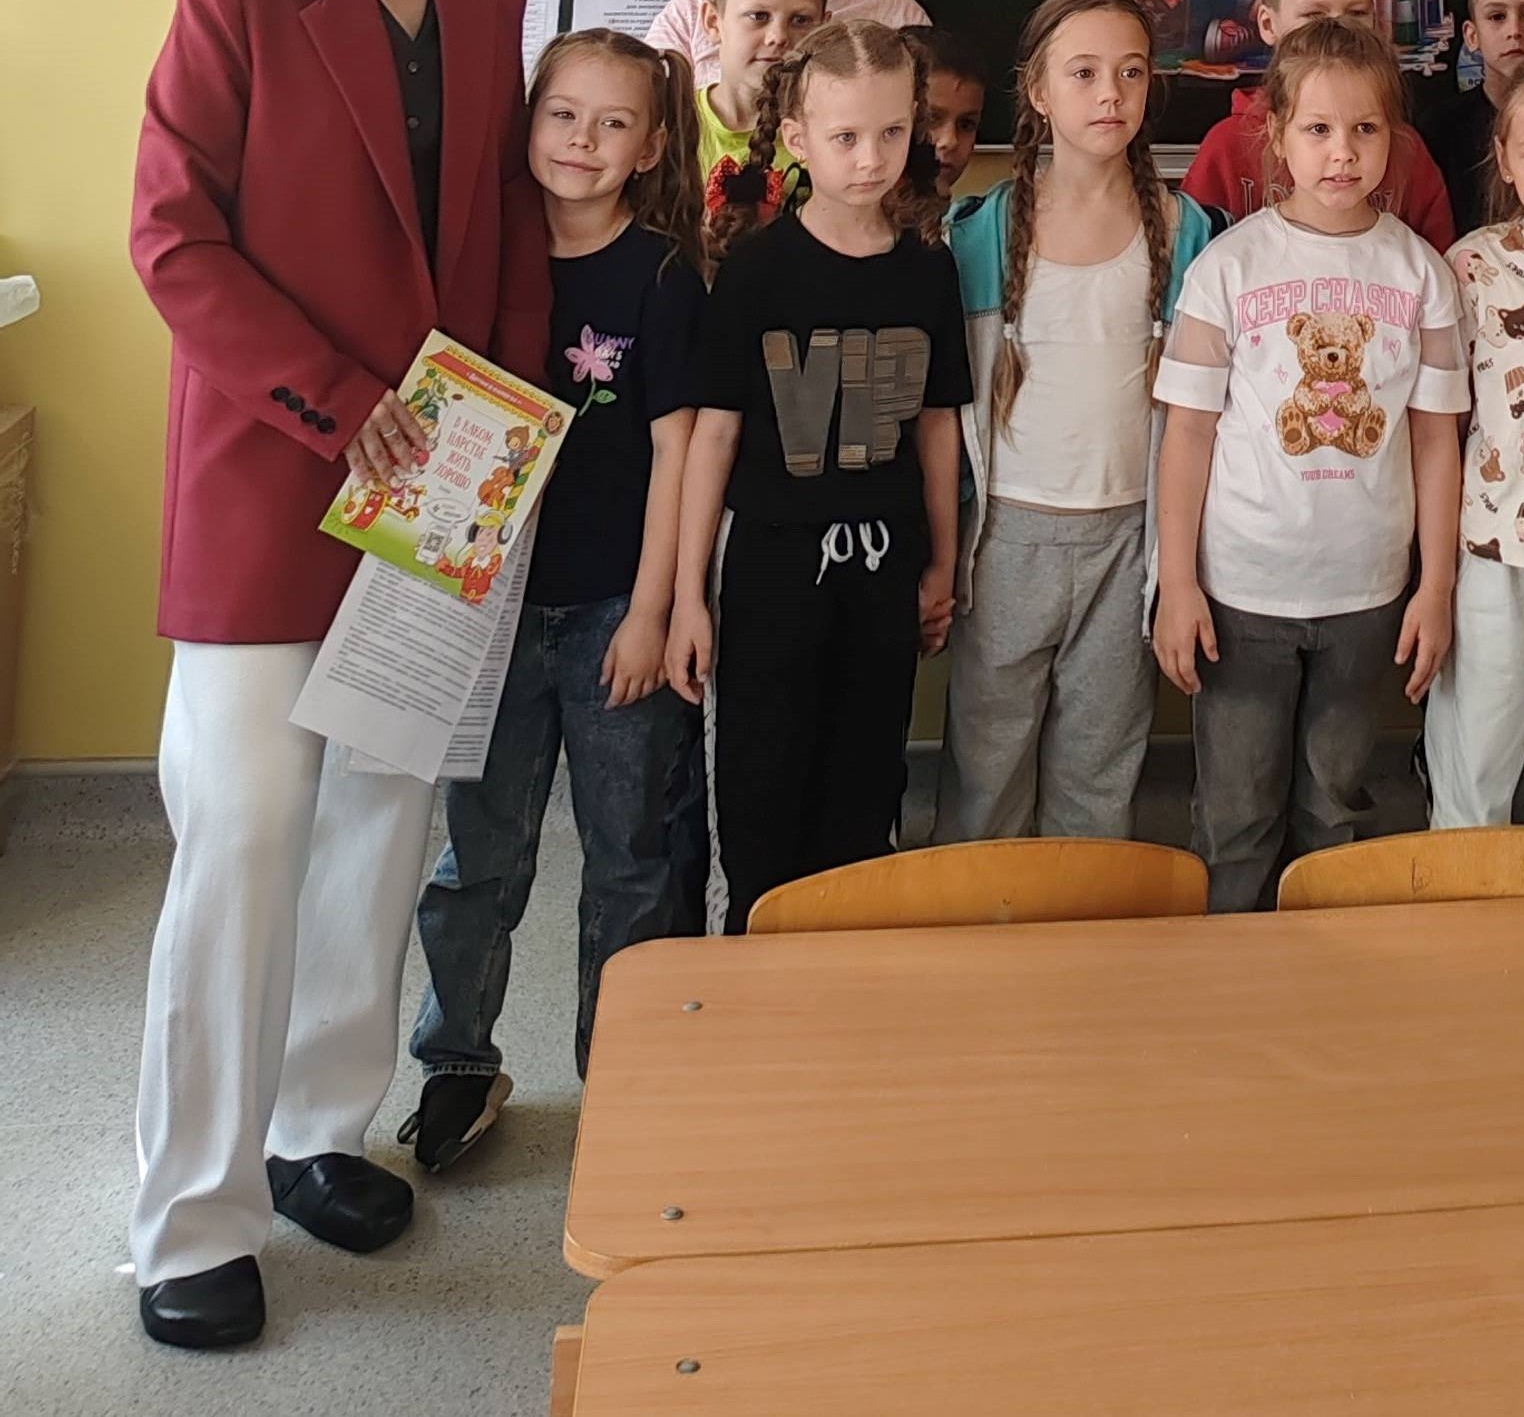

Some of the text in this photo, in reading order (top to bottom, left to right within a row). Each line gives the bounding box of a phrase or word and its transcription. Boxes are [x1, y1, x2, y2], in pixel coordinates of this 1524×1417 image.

[1237, 279, 1307, 333] KEEP
[762, 326, 931, 477] VIP
[1301, 468, 1354, 481] YOUR DREAMS
